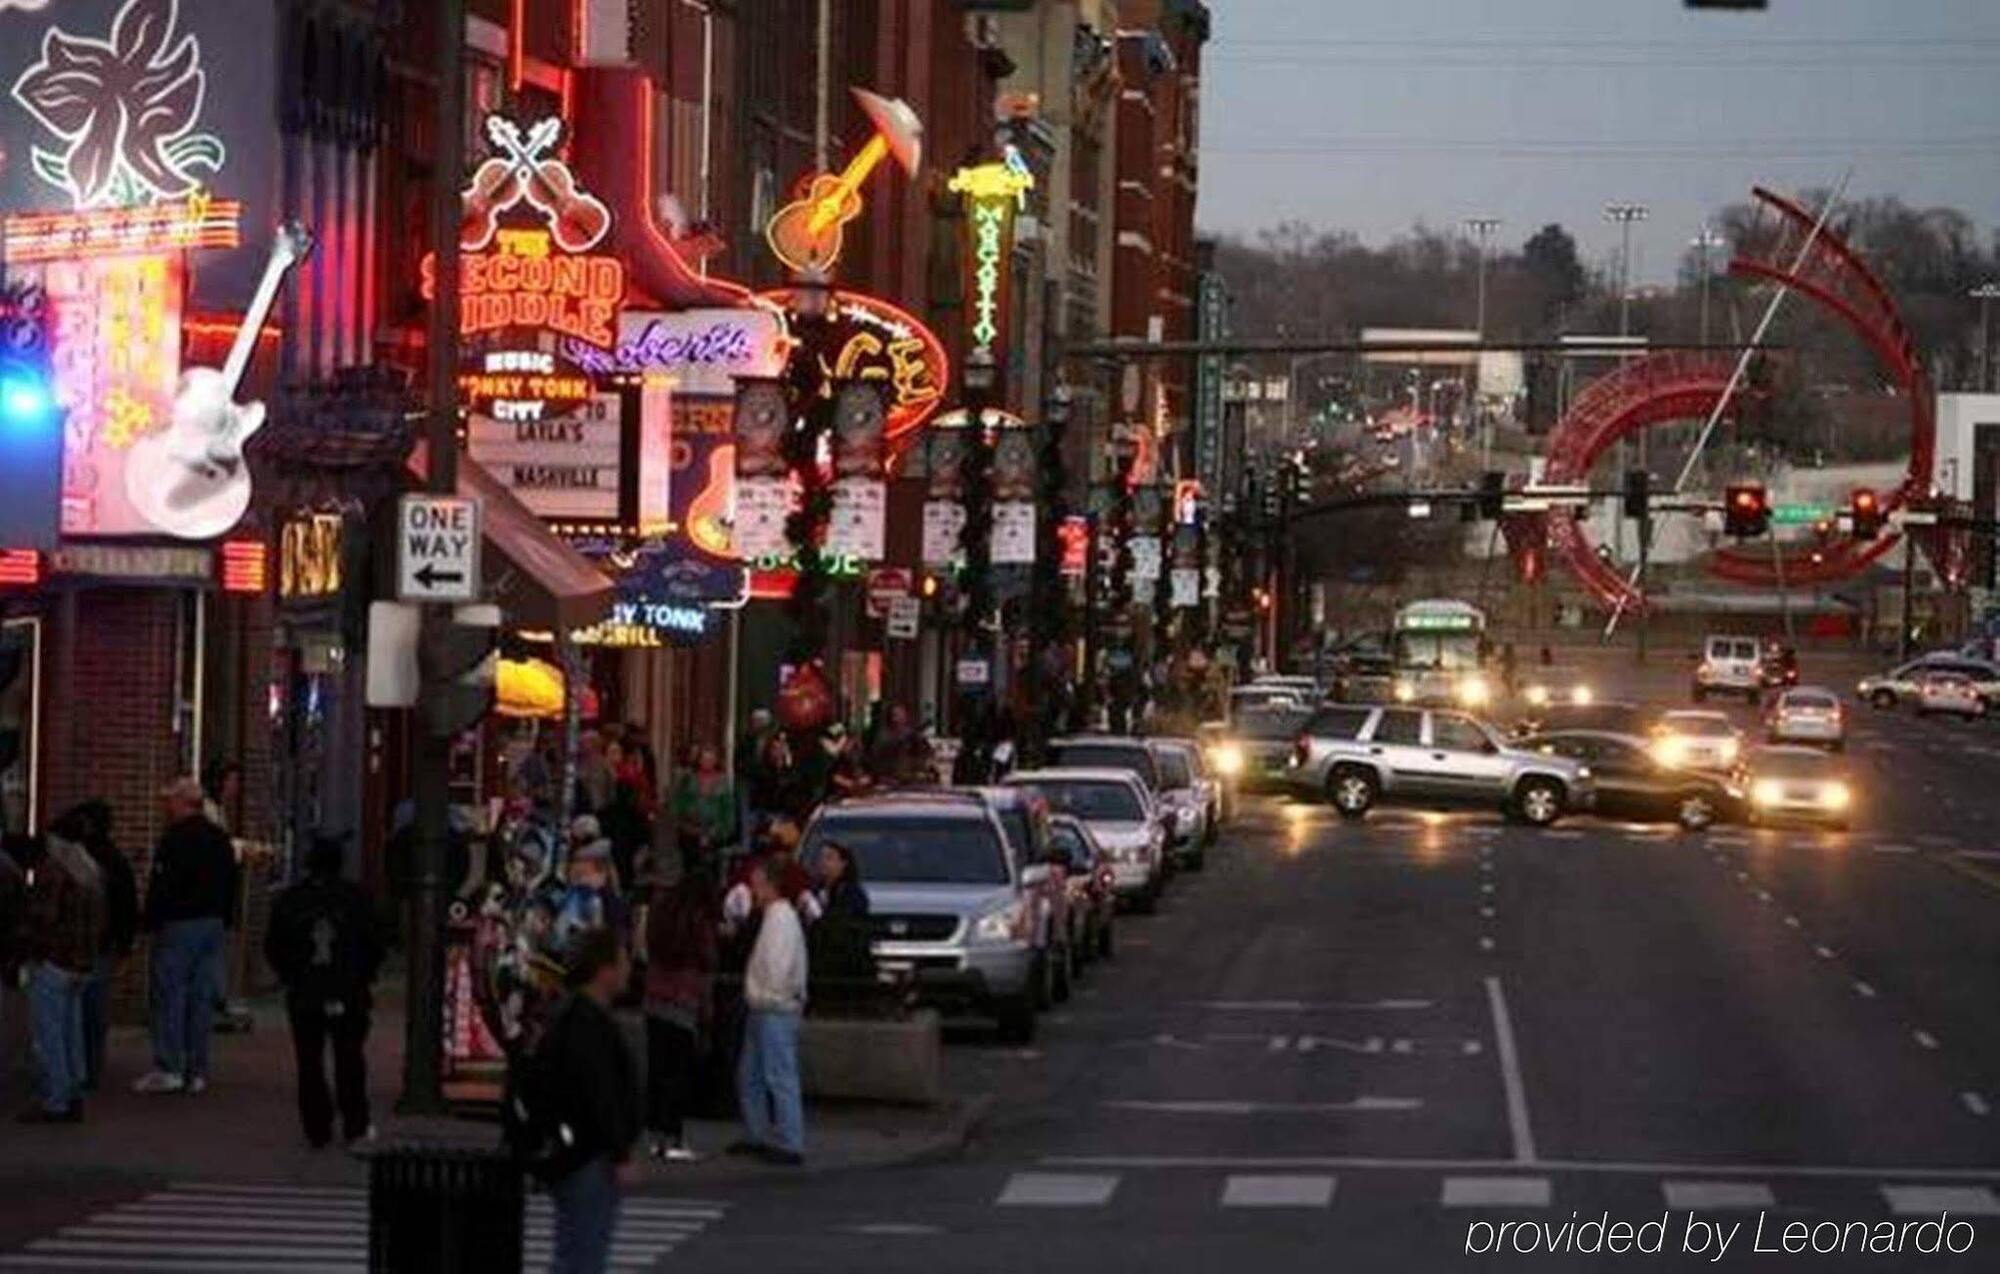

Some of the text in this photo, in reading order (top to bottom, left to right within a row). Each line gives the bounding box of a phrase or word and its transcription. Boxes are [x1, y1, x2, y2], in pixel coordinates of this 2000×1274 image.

[461, 293, 616, 350] IDDLE
[410, 505, 467, 530] ONE
[409, 534, 468, 558] WAY
